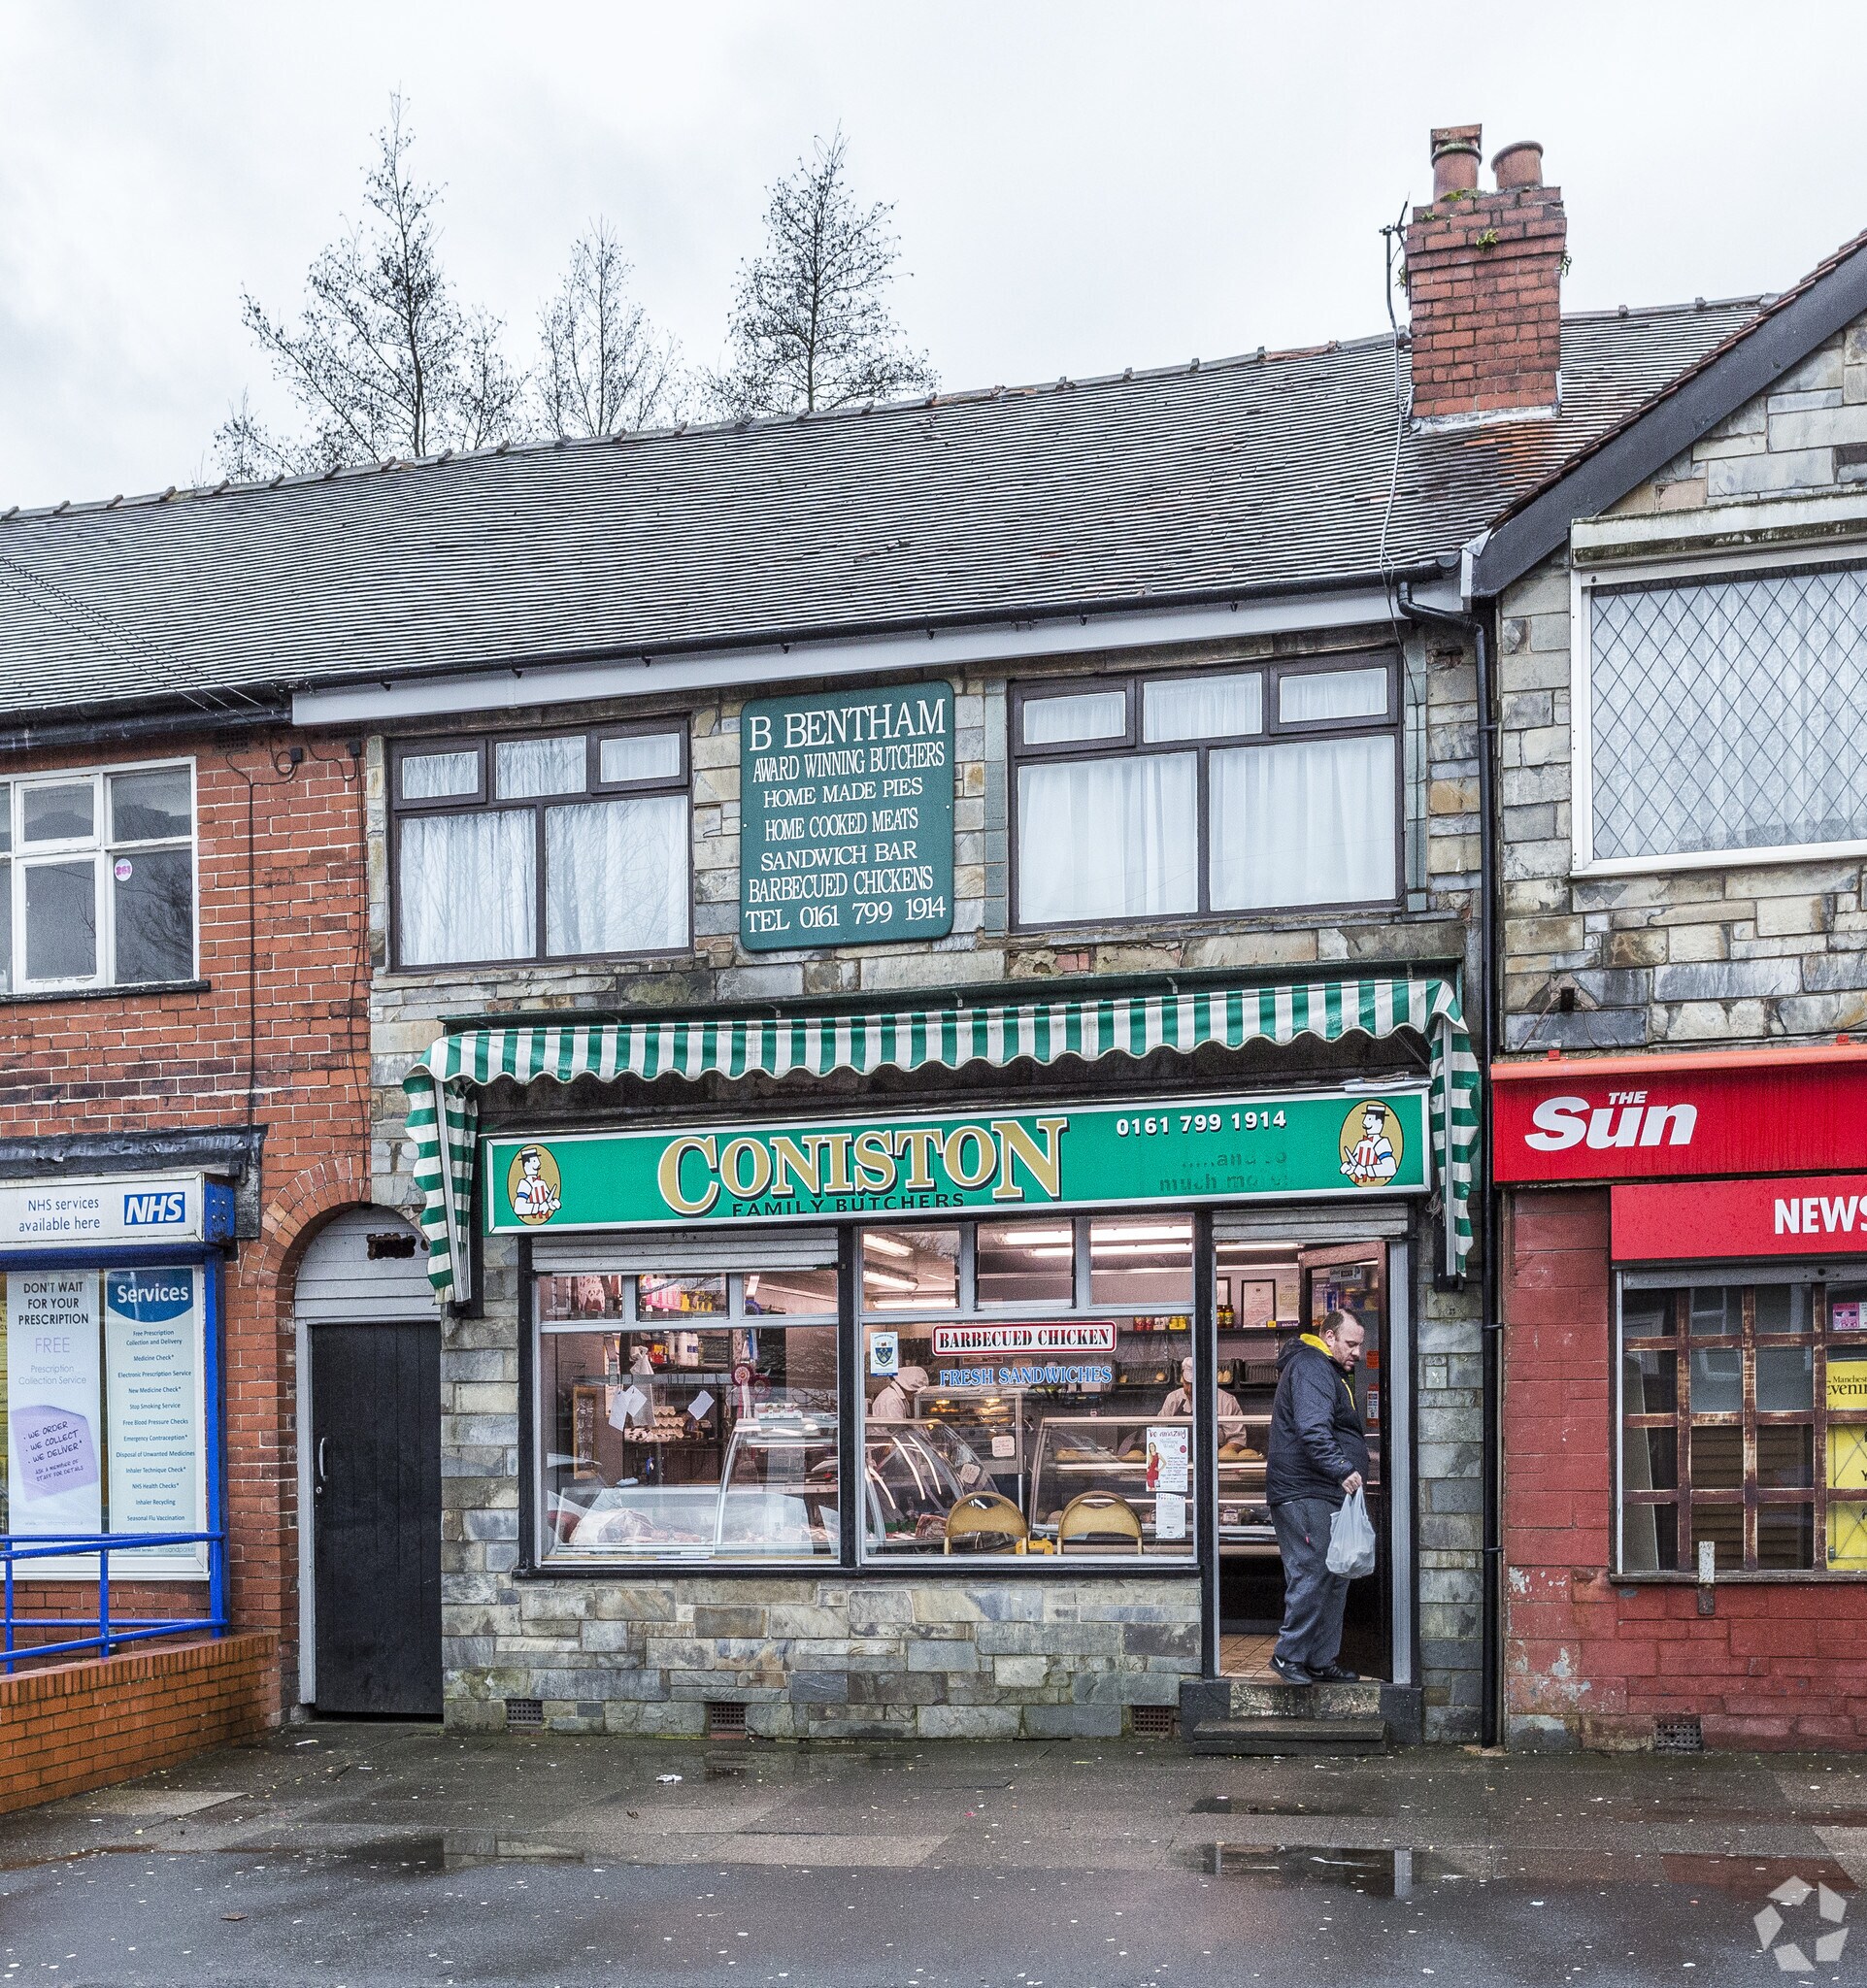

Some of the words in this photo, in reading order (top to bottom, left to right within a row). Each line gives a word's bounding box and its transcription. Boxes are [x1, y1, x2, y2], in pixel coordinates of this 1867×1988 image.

[750, 715, 773, 751] B
[784, 698, 946, 748] BENTHAM
[752, 755, 800, 782] AWARD
[804, 748, 866, 778] WINNING
[870, 741, 946, 773] BUTCHERS
[763, 787, 816, 808] HOME
[822, 781, 877, 804] MADE
[883, 777, 923, 798] PIES
[765, 817, 805, 842] HOME
[809, 812, 867, 838] COOKED
[872, 807, 918, 833] MEATS
[760, 845, 867, 872] SANDWICH
[875, 841, 917, 863] BAR
[749, 873, 848, 903] BARBECUED
[853, 865, 934, 896] CHICKENS
[745, 909, 790, 933] TEL
[799, 905, 840, 929] 0161
[851, 901, 893, 925] 799
[905, 896, 947, 920] 1914
[1608, 1091, 1648, 1106] THE
[1117, 1117, 1169, 1137] 0161
[1180, 1114, 1221, 1133] 799
[1231, 1110, 1286, 1131] 1914
[1524, 1096, 1698, 1151] Sun
[657, 1117, 1069, 1218] CONISTON
[28, 1199, 52, 1211] NHS
[55, 1196, 99, 1210] services
[126, 1194, 183, 1223] NHS
[732, 1199, 824, 1217] FAMILY
[836, 1193, 964, 1212] BUTCHERS
[18, 1216, 70, 1232] available
[75, 1215, 100, 1229] here
[23, 1282, 55, 1293] DON'T
[58, 1281, 83, 1292] WAIT
[117, 1283, 189, 1304] Services
[27, 1299, 48, 1309] FOR
[50, 1298, 79, 1309] YOUR
[18, 1313, 88, 1325] PRESCRIPTION
[35, 1338, 70, 1353] FREE
[939, 1331, 1033, 1348] BARBECUED
[1038, 1329, 1110, 1345] CHICKEN
[31, 1365, 74, 1374] Prescription
[939, 1369, 994, 1386] FRESH
[998, 1366, 1113, 1384] SANDWICHES
[18, 1376, 56, 1385] Collection
[58, 1376, 86, 1385] Service
[28, 1430, 40, 1440] WE
[43, 1421, 68, 1435] ORDER
[30, 1442, 43, 1451] WE
[45, 1429, 79, 1446] COLLECT
[1159, 1429, 1186, 1440] amazing
[32, 1453, 45, 1463] WE
[50, 1461, 71, 1472] MEMBER
[36, 1474, 52, 1482] STAFF
[63, 1465, 84, 1474] DETAILS
